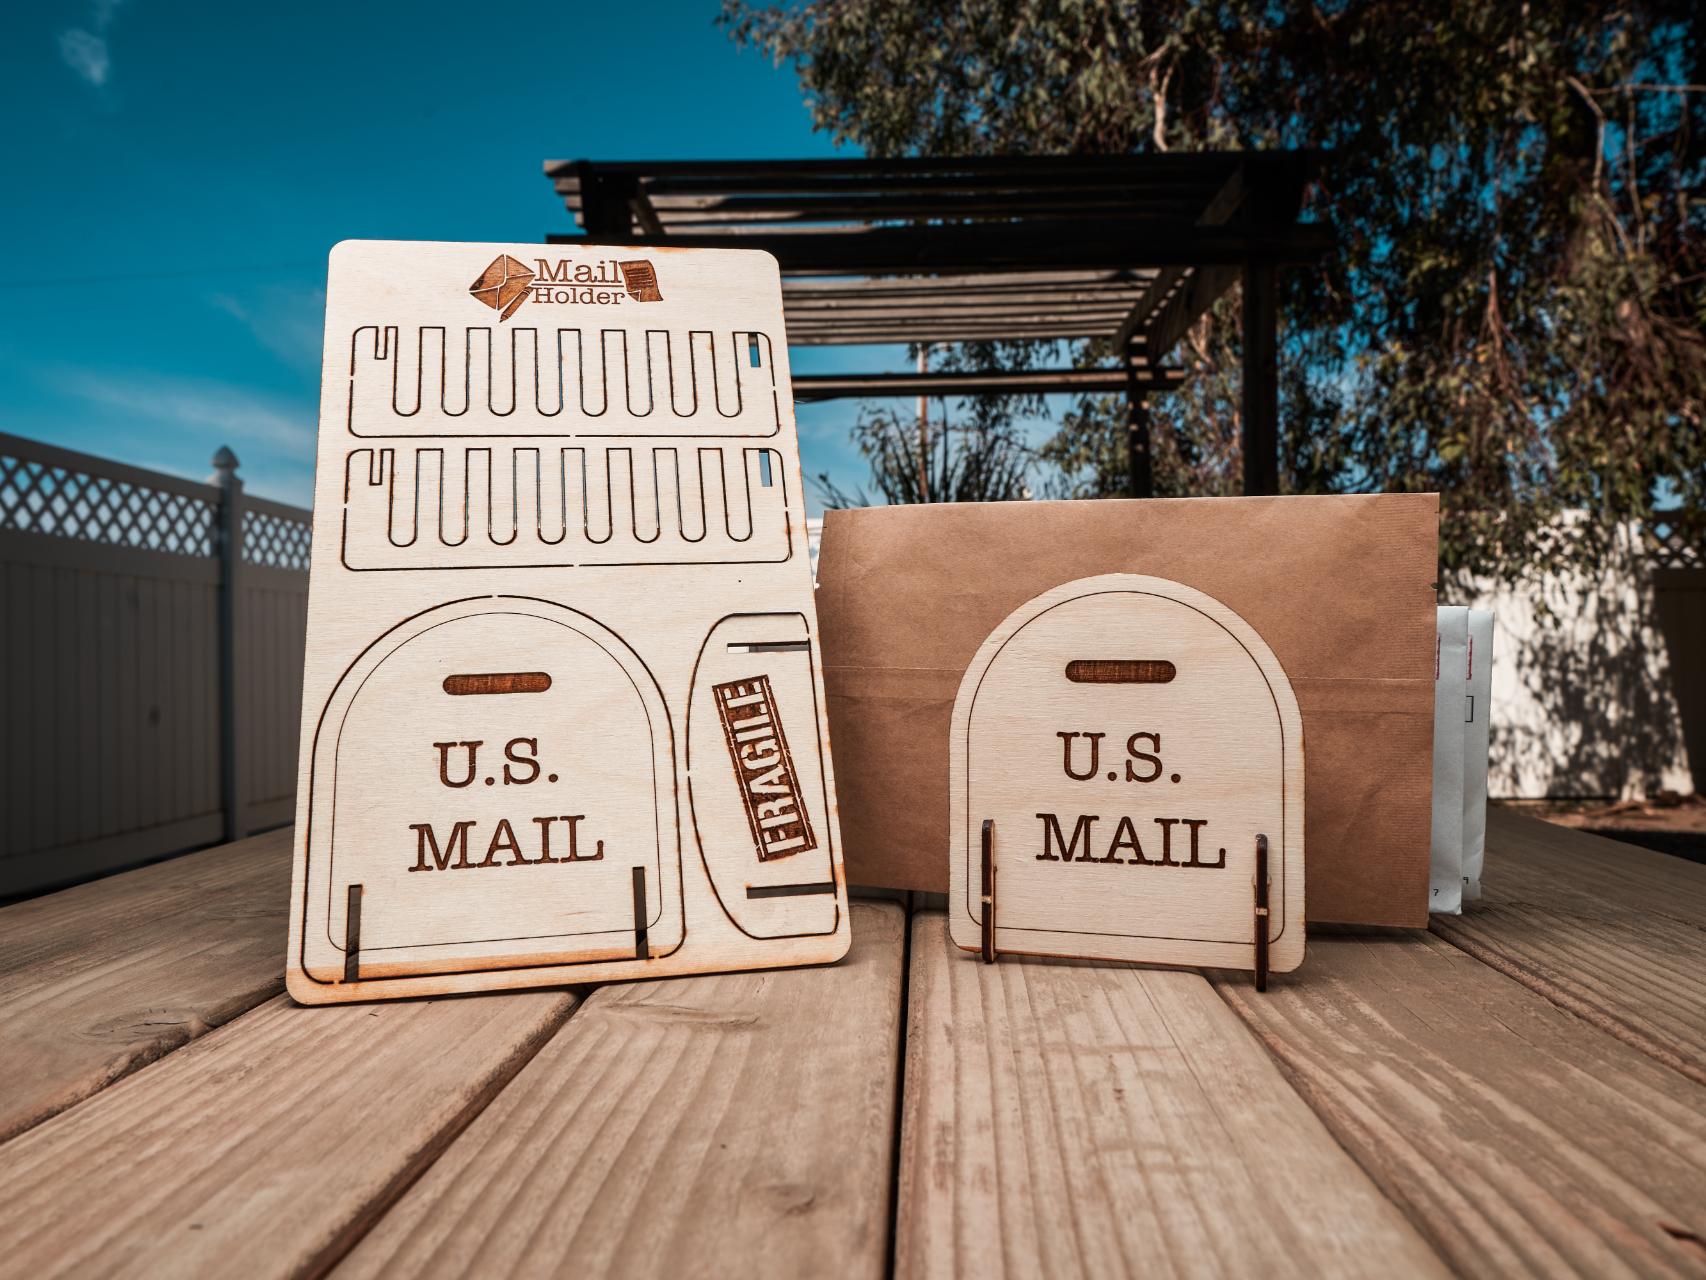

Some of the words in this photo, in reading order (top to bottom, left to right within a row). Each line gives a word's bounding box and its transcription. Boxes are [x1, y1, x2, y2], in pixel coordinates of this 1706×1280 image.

[532, 287, 626, 305] Holder
[533, 258, 623, 284] Mail
[433, 737, 559, 789] U.S.
[722, 680, 807, 855] FRAGILE
[1056, 731, 1182, 784] U.S.
[408, 814, 604, 873] MAIL
[1035, 812, 1227, 870] MAIL
